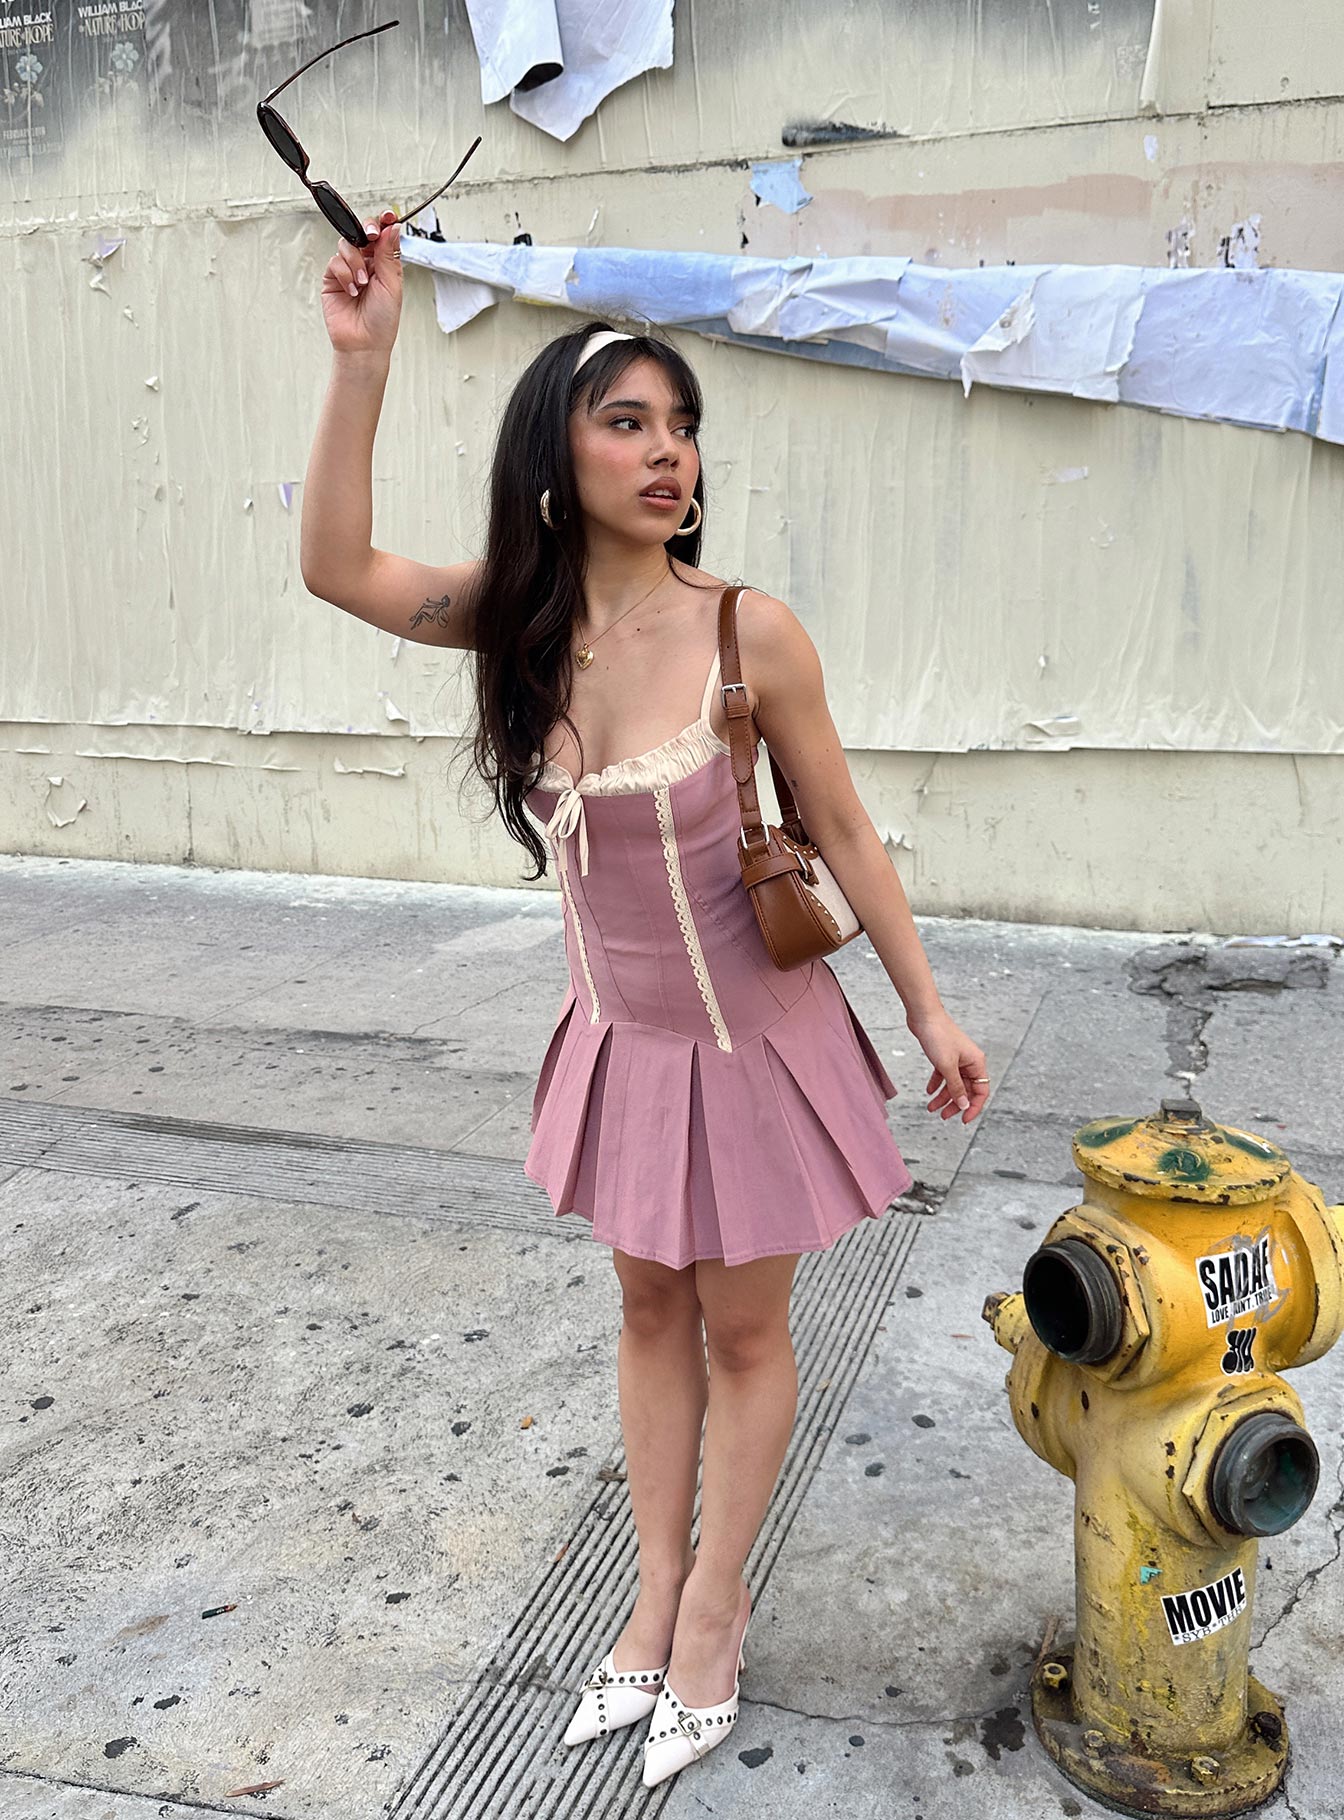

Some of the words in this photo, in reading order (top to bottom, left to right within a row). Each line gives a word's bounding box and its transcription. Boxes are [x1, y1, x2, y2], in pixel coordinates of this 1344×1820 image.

[23, 11, 53, 25] BLACK
[78, 2, 117, 18] WILLIAM
[119, 0, 143, 12] BLAC
[25, 23, 55, 45] HOPE
[85, 14, 118, 37] NATURE
[120, 11, 146, 32] HOP
[1162, 1567, 1246, 1636] MOVIE
